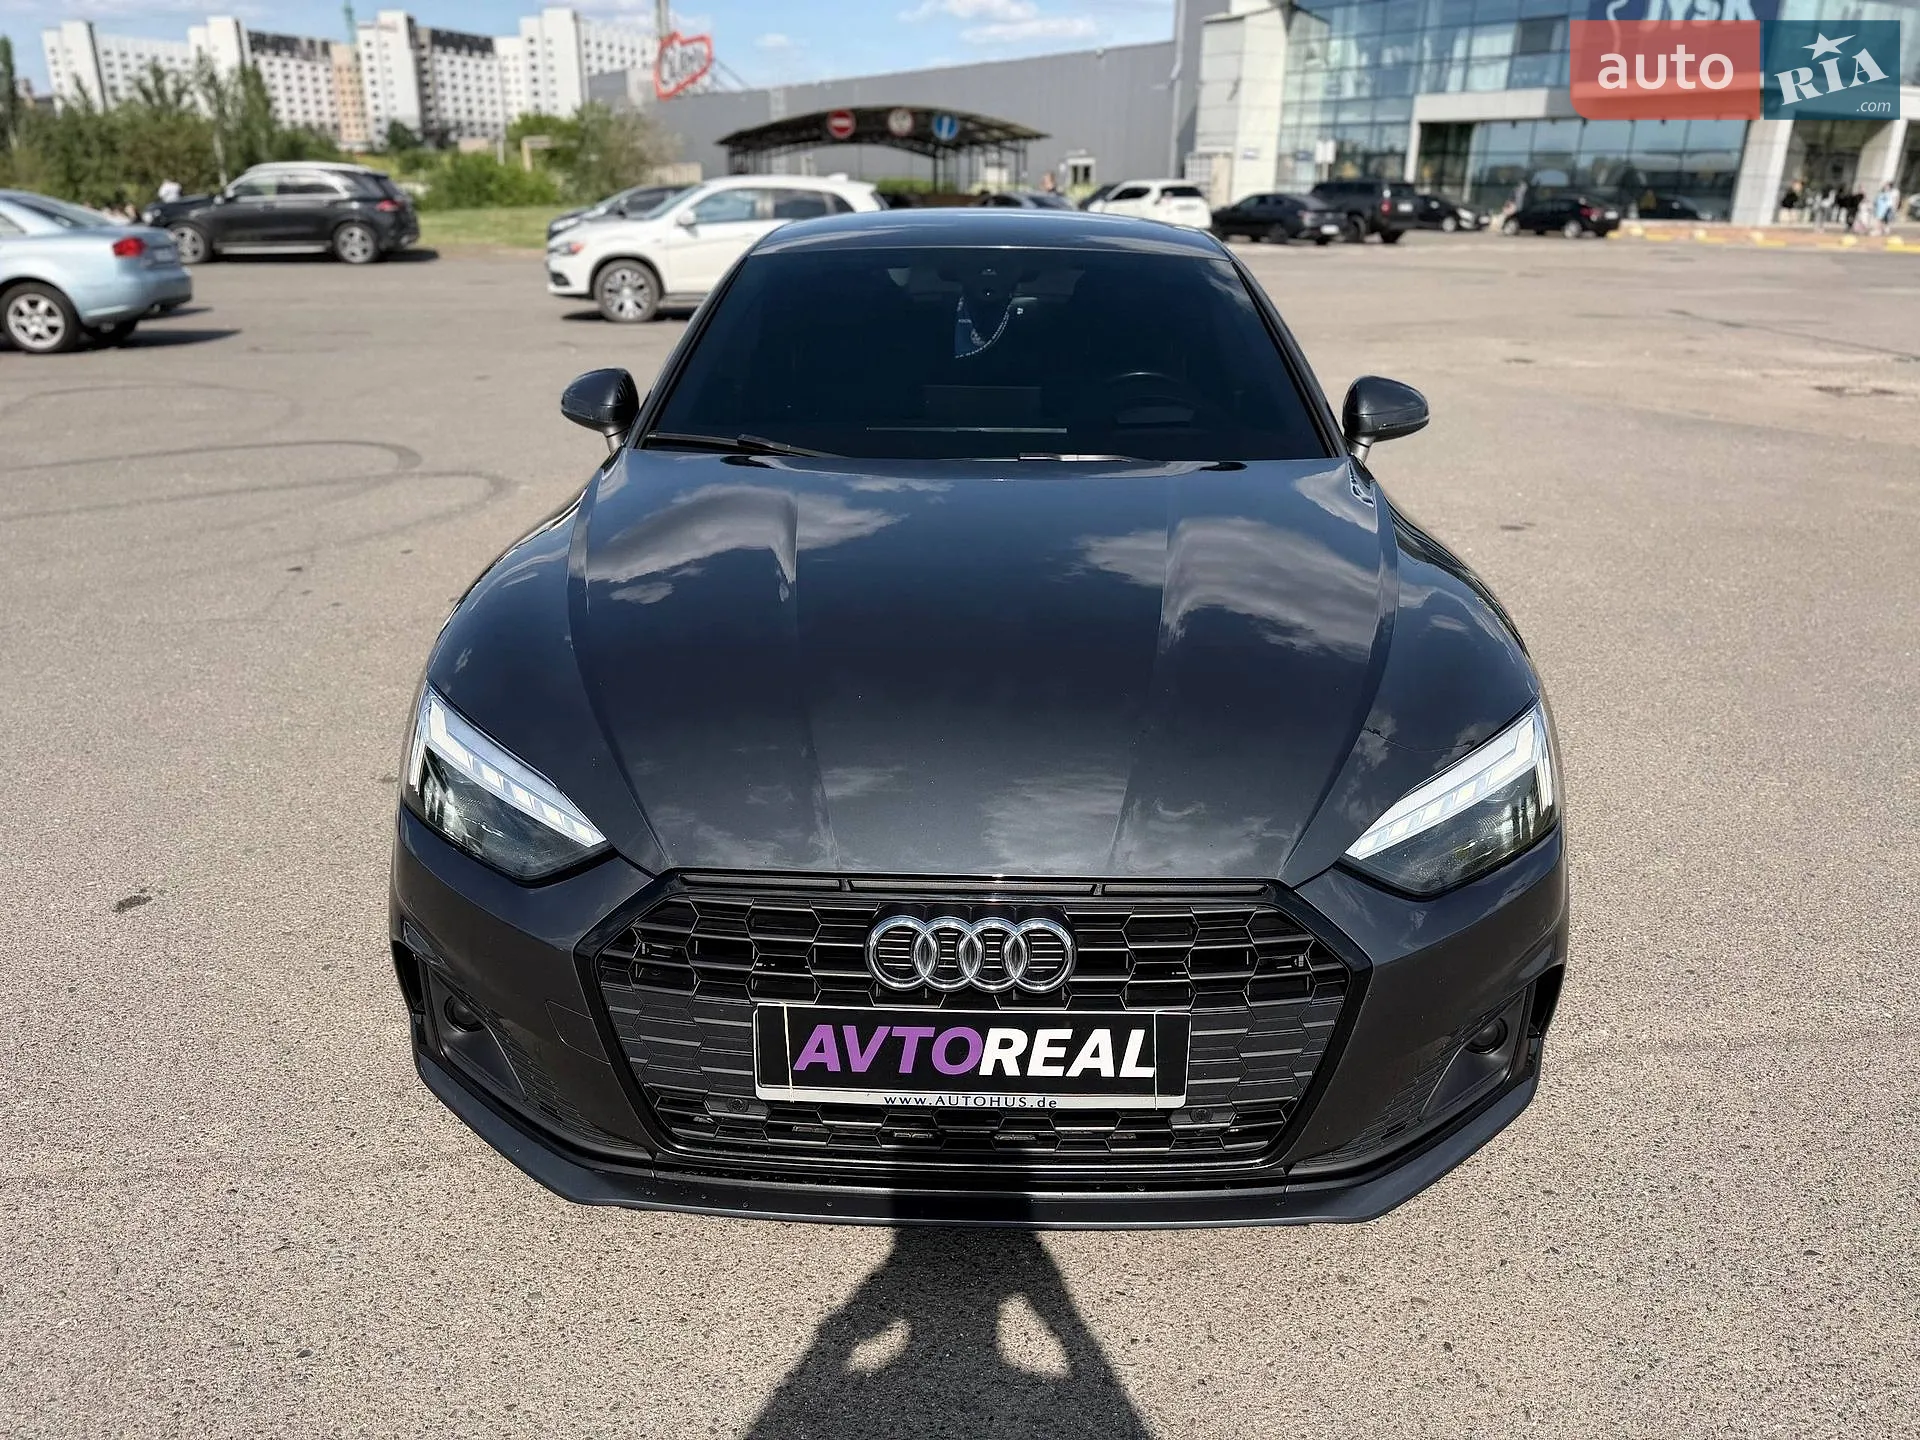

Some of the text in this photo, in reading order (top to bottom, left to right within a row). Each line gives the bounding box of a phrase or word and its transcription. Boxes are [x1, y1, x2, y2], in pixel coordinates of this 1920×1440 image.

[1638, 0, 1757, 31] JYSK
[792, 1024, 1156, 1079] AVTOREAL
[883, 1095, 1058, 1109] www.AUTOHUS.de
